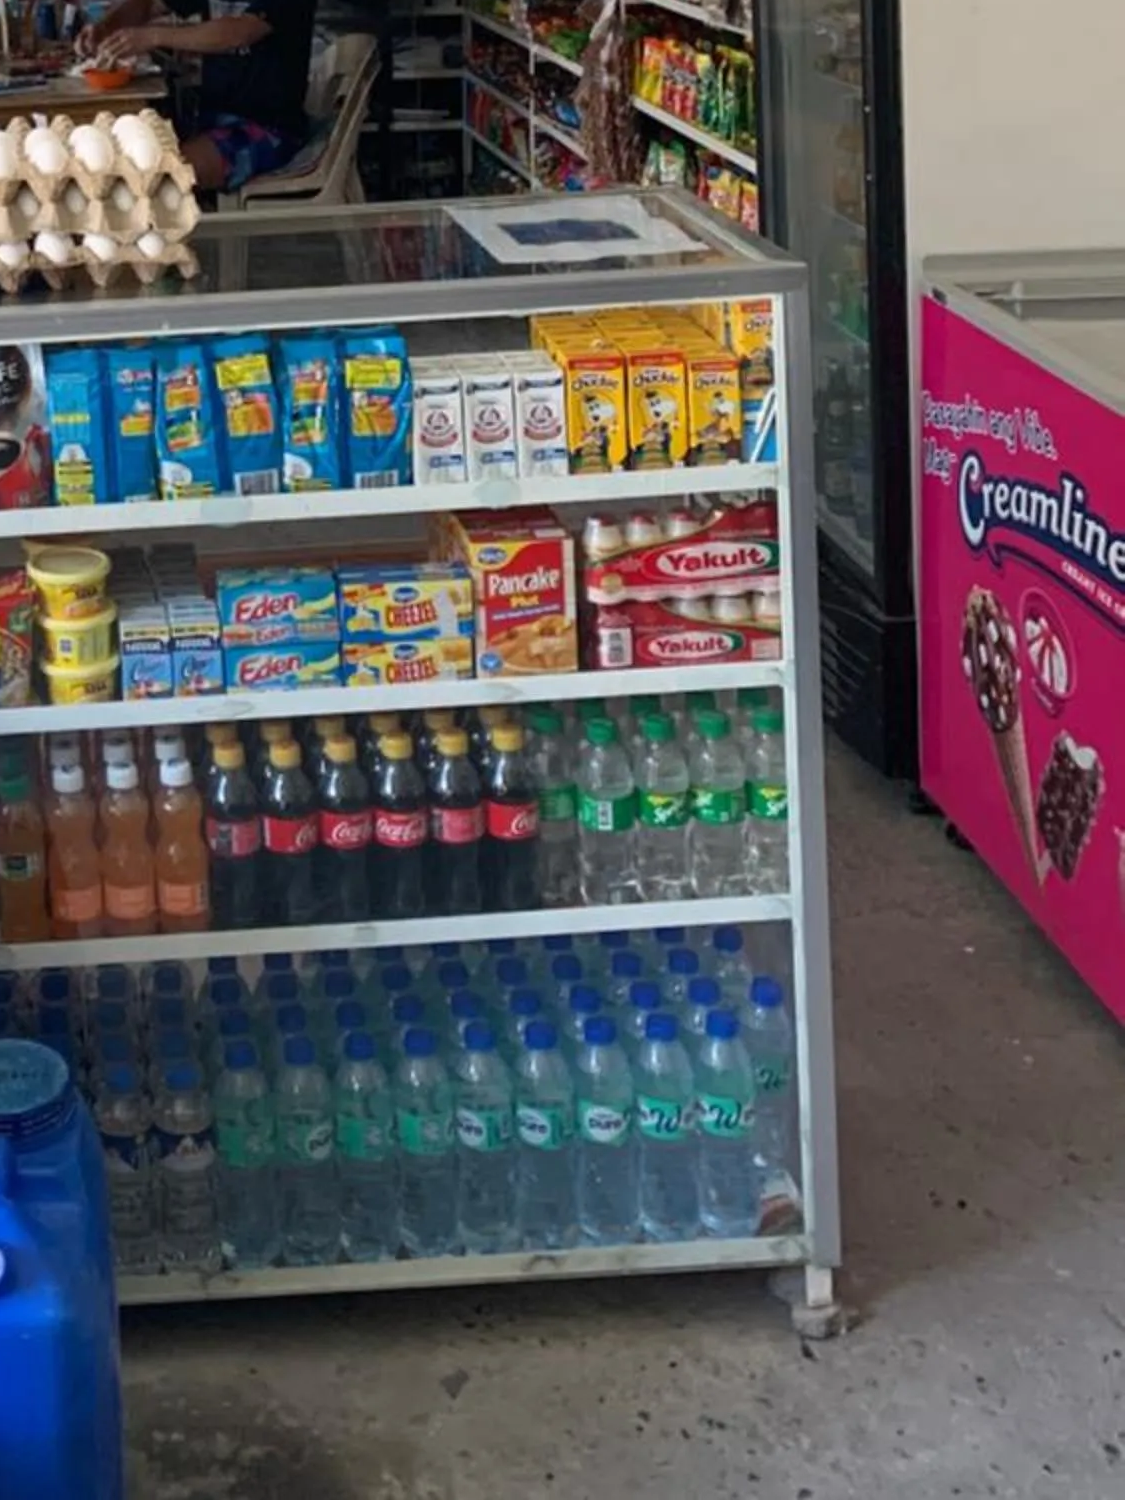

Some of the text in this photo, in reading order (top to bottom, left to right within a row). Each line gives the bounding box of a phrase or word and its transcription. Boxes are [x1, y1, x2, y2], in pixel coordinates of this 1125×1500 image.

[959, 454, 1125, 582] Creamline
[666, 548, 766, 573] Yakult
[487, 565, 561, 597] Pancake
[234, 594, 299, 626] Eden
[655, 636, 730, 654] Yakult
[238, 655, 301, 685] Eden
